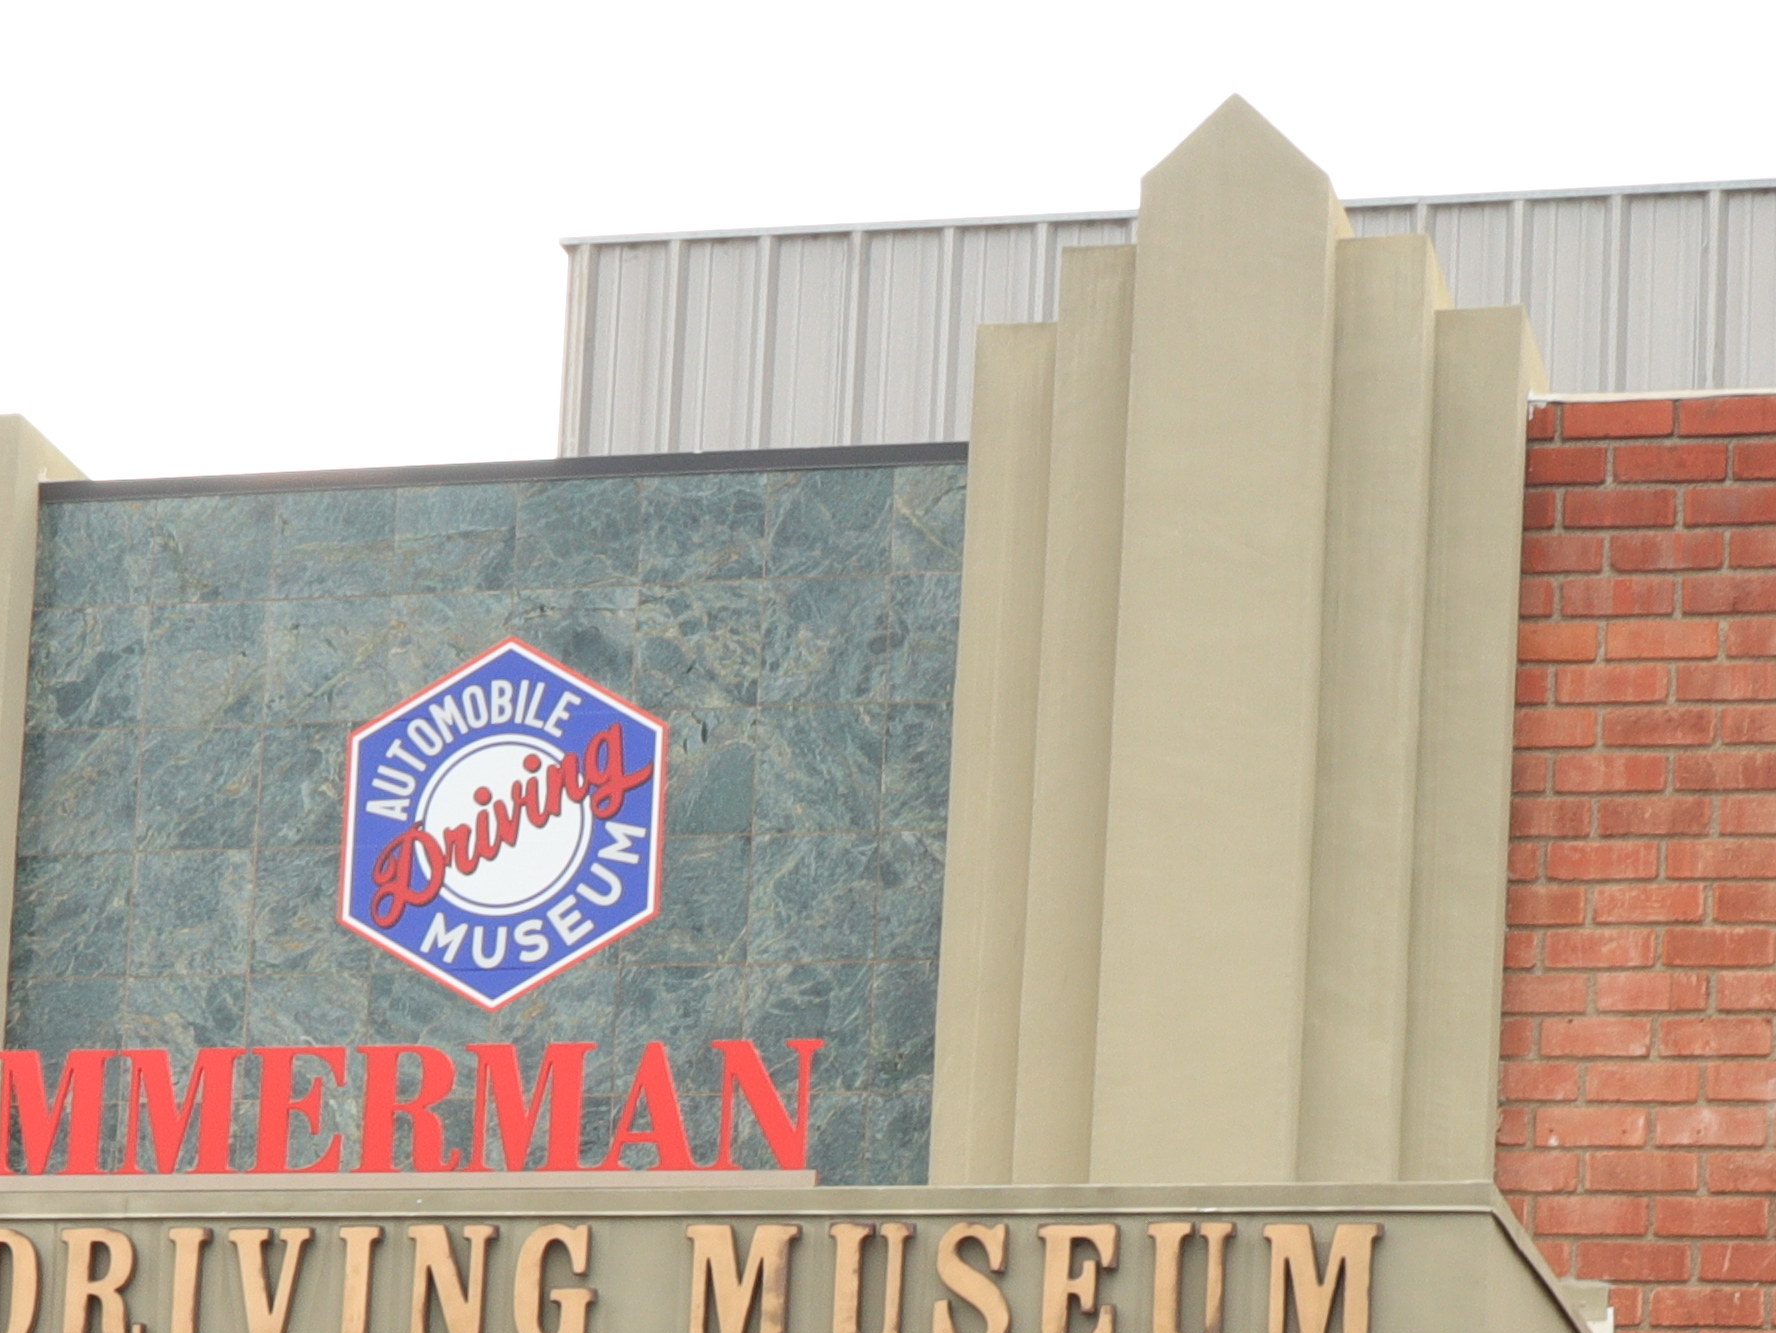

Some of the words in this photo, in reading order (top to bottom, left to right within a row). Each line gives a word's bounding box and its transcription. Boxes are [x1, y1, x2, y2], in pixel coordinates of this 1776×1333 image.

[365, 679, 582, 822] AUTOMOBILE
[371, 721, 654, 930] Driving
[420, 821, 647, 969] MUSEUM
